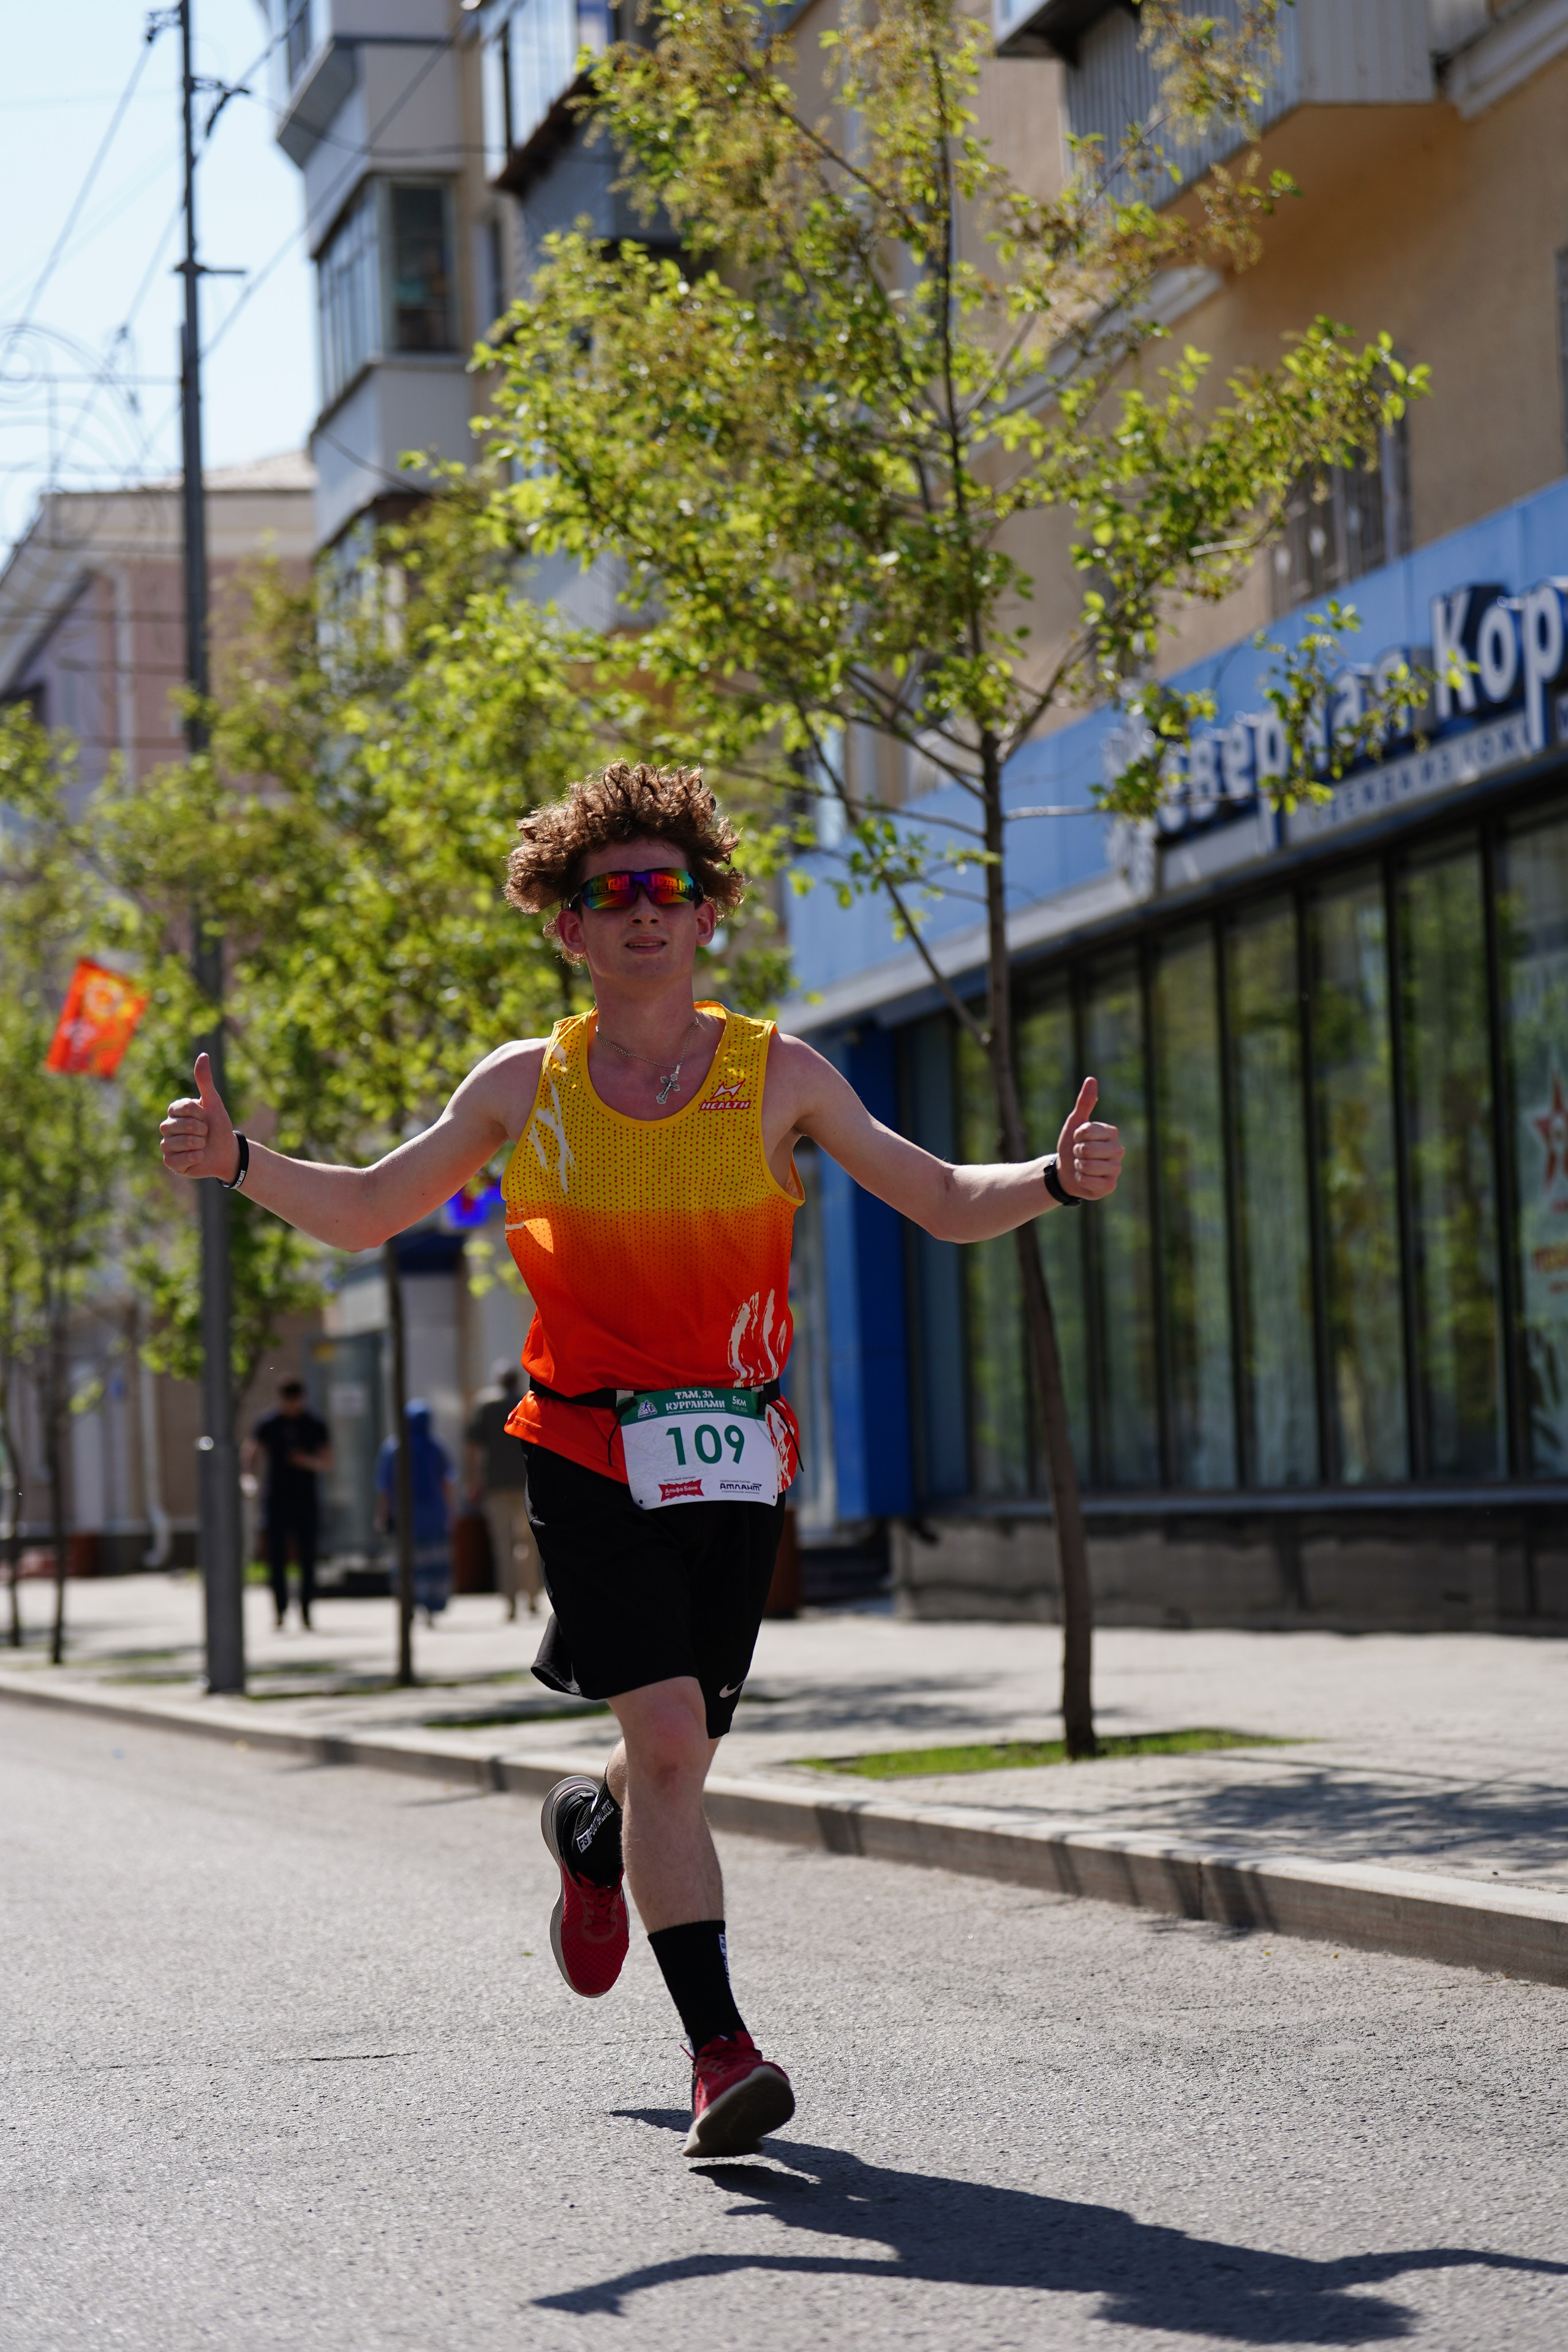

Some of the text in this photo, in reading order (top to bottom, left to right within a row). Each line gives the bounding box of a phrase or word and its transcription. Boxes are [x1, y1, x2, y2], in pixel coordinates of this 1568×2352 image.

[674, 1390, 714, 1400] ТАМ, ЗА
[665, 1400, 725, 1411] КУРГАНАМИ
[666, 1424, 745, 1466] 109
[665, 1487, 684, 1495] Альфа
